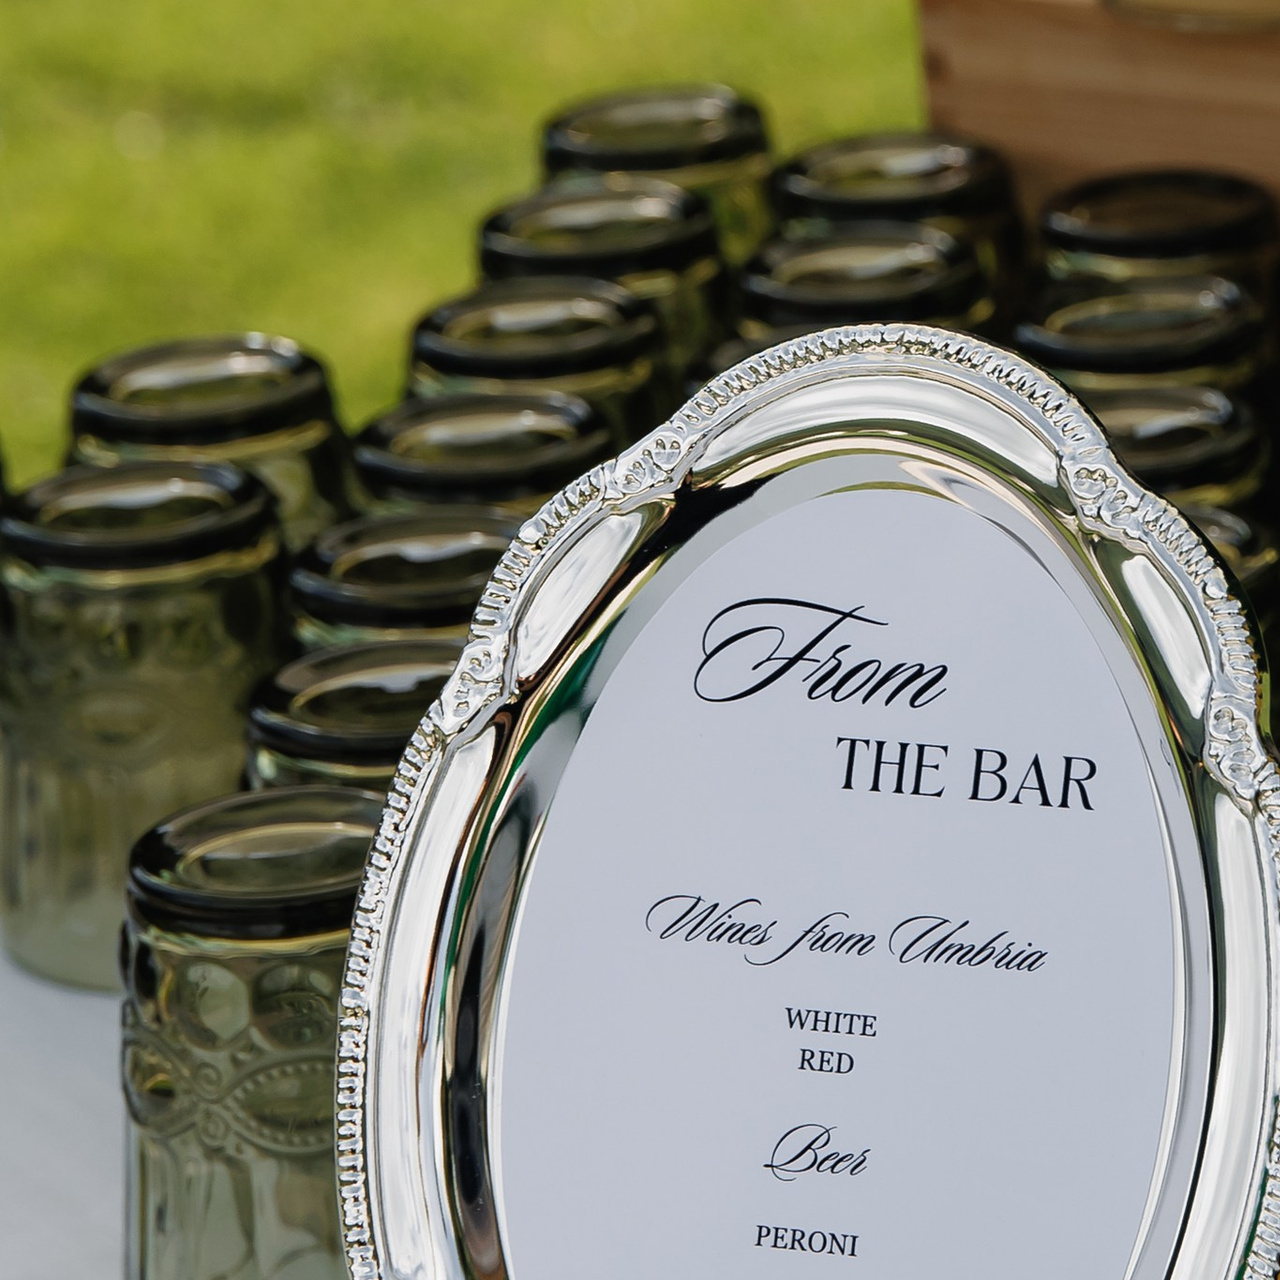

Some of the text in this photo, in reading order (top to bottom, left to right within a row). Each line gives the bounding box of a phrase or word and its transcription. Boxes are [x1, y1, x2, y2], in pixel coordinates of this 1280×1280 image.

[693, 597, 949, 709] From
[835, 736, 1097, 811] THE BAR
[645, 894, 1049, 972] Wines from Umbria
[784, 1007, 877, 1038] WHITE
[797, 1048, 855, 1075] RED
[762, 1123, 872, 1182] Beer
[754, 1224, 860, 1258] PERONI
